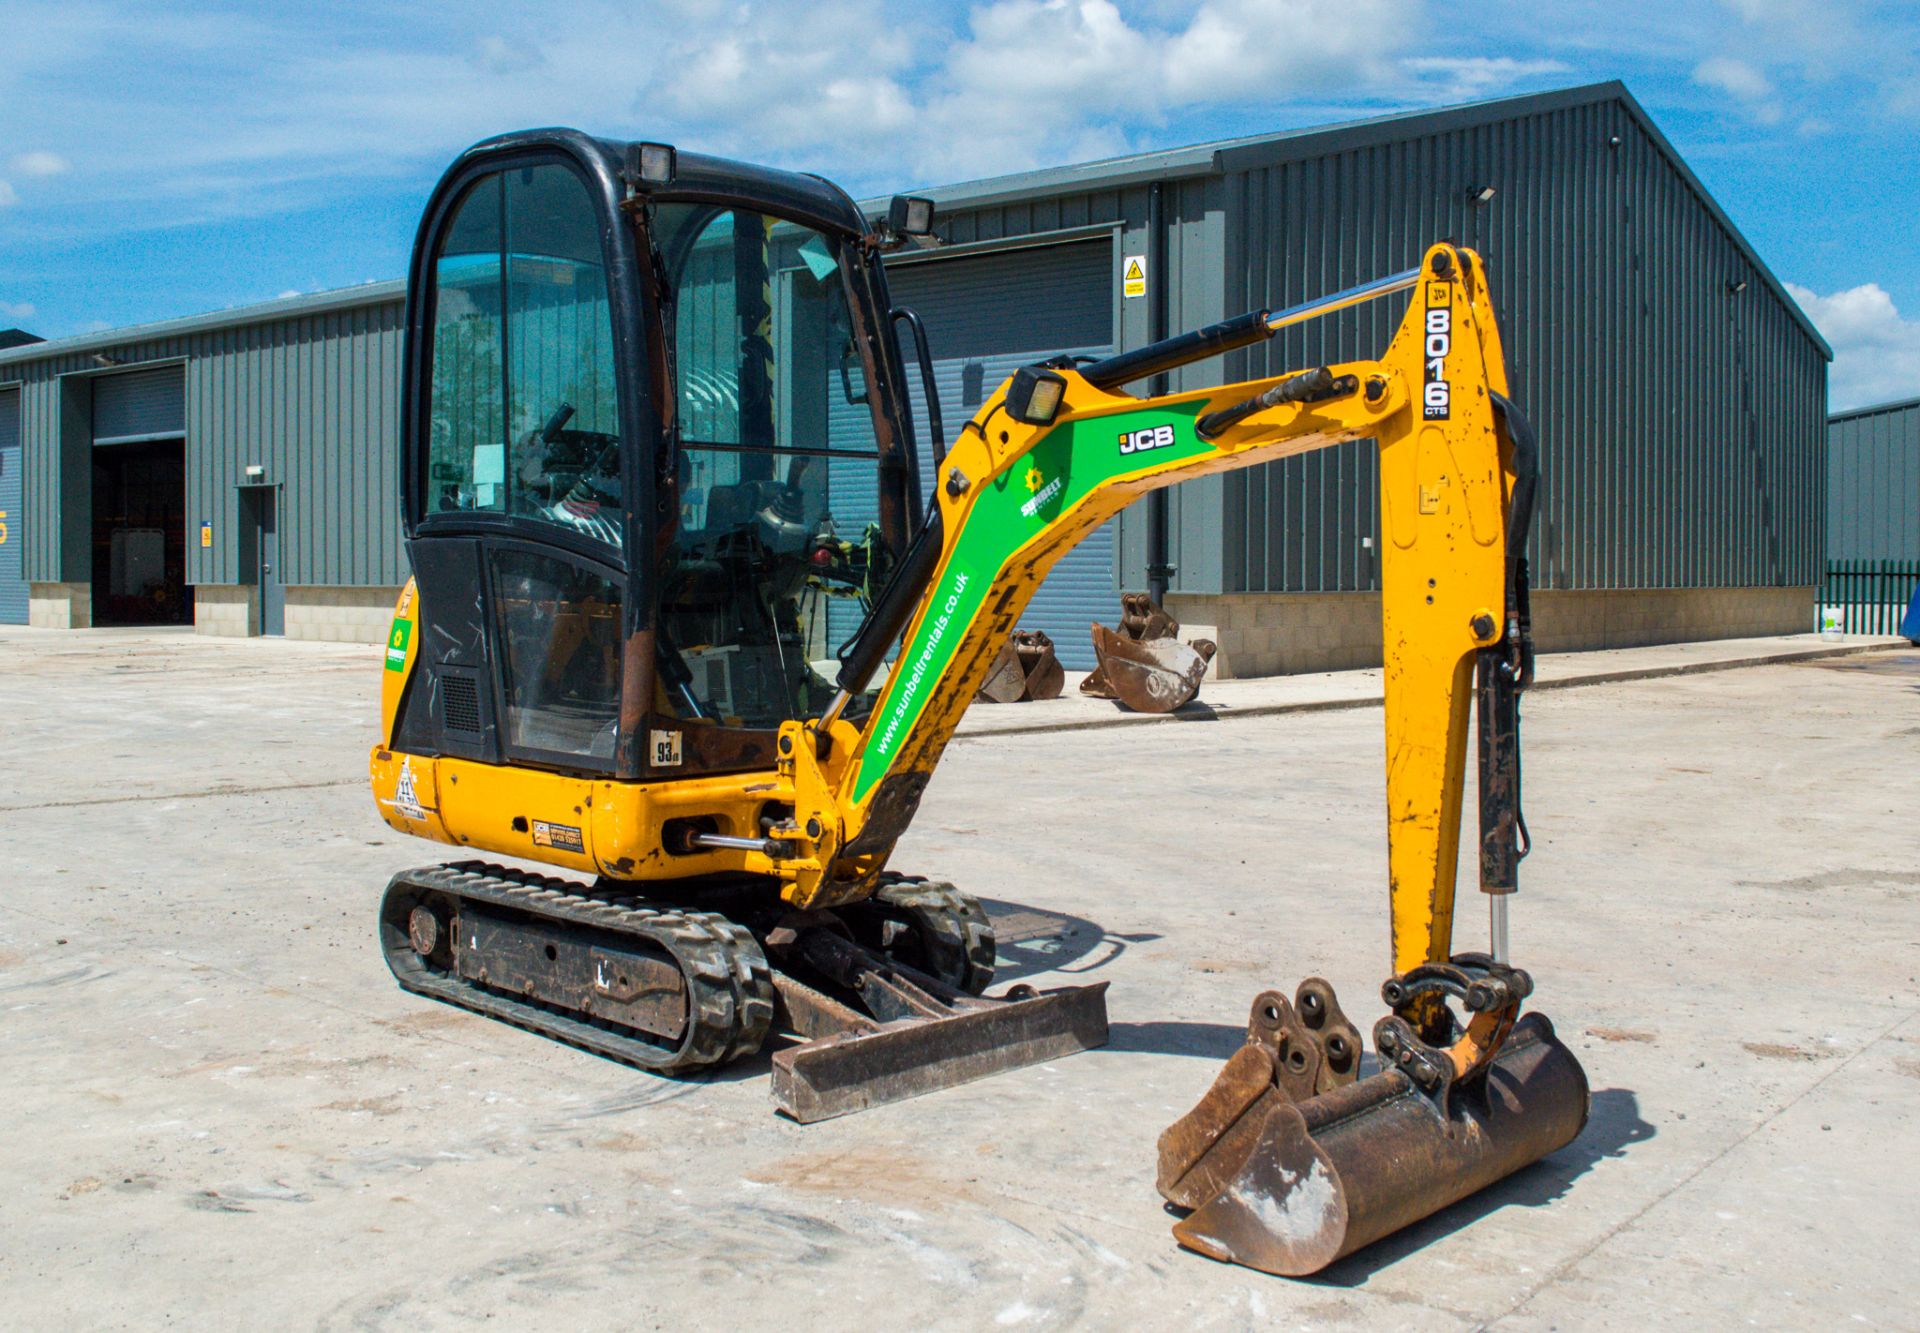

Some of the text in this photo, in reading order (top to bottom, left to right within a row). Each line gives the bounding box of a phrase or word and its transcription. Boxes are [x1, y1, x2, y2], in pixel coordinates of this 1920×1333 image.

[1424, 309, 1450, 407] 8016
[1424, 406, 1448, 415] CTS
[1119, 425, 1174, 454] JCB
[877, 571, 969, 755] www.sunbeltrentals.co.uk
[657, 742, 672, 762] 93
